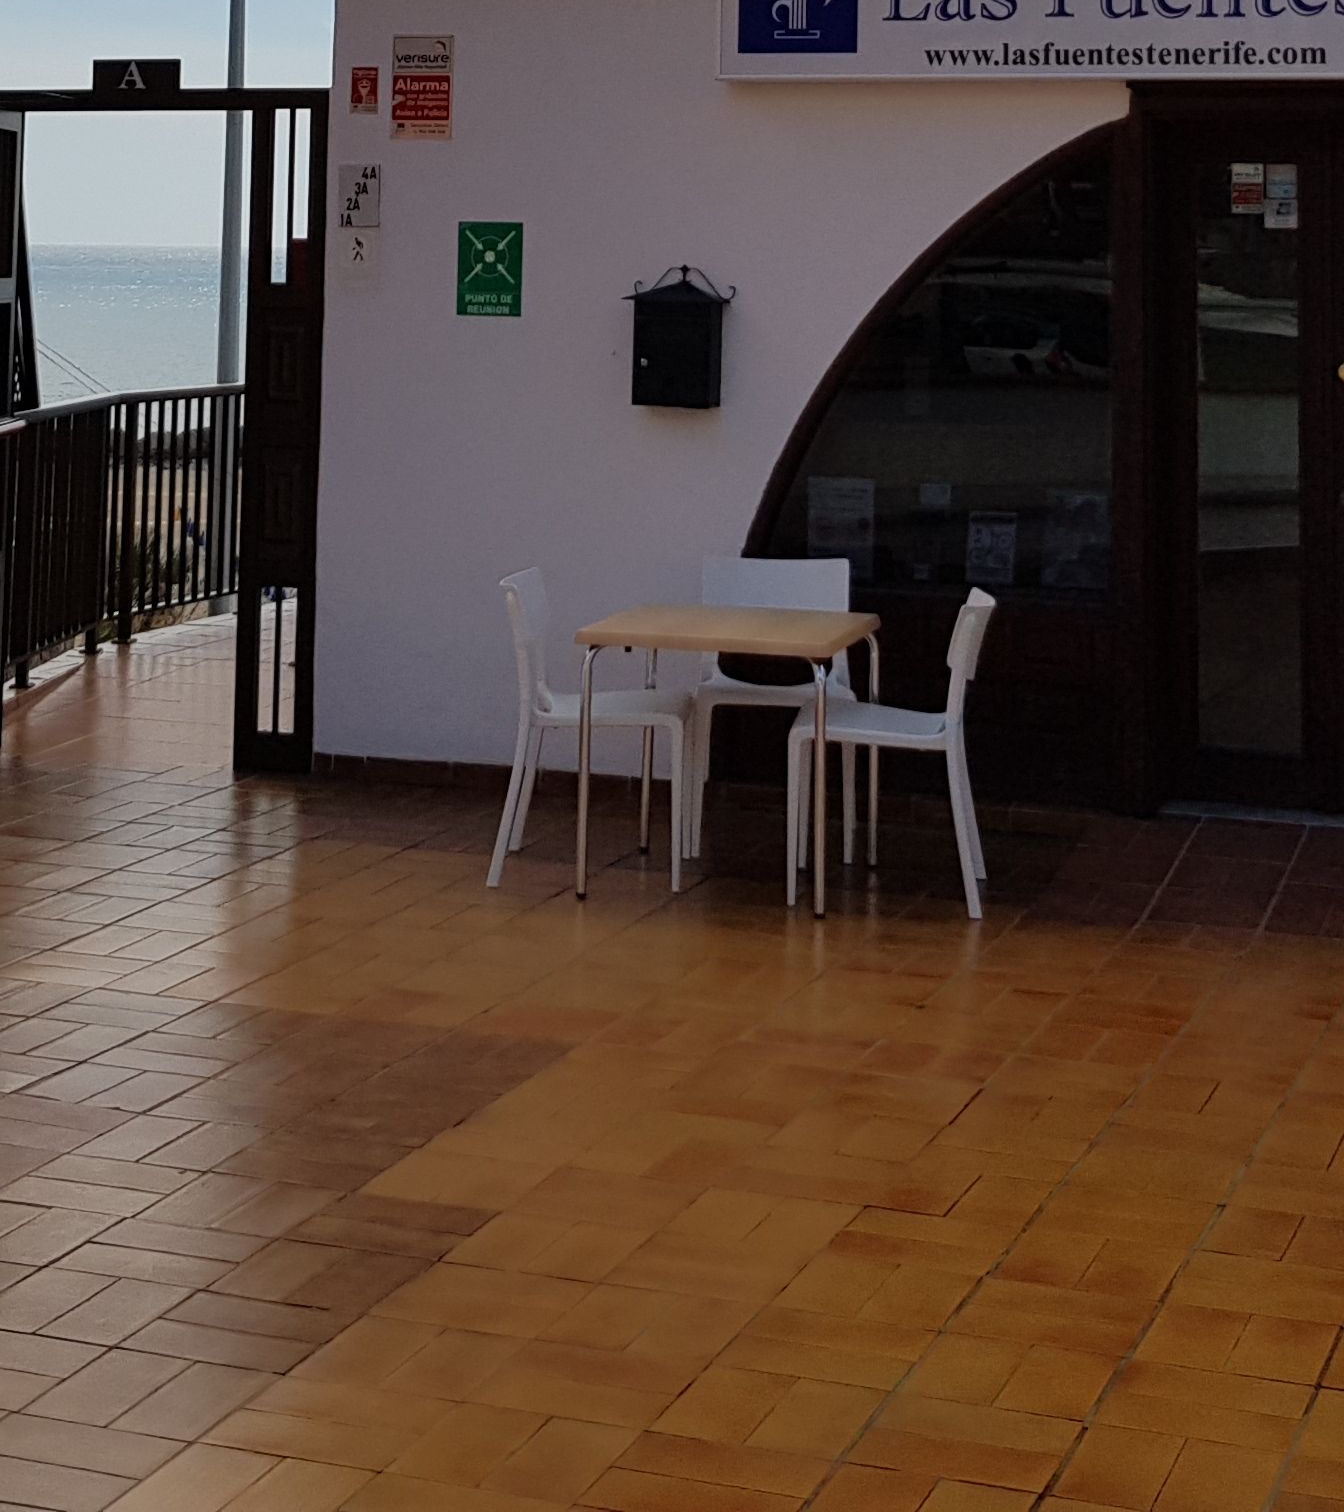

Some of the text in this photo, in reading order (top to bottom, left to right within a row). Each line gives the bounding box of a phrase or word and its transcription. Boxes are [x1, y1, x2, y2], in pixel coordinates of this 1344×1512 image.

[924, 40, 1328, 69] www.lasfuentestenerife.com
[118, 60, 146, 89] A
[394, 77, 449, 91] Alarma
[361, 166, 377, 179] 4A
[354, 181, 369, 195] 3A
[346, 197, 361, 211] 2A
[340, 213, 353, 227] 1A
[465, 294, 513, 304] PUNTO DE
